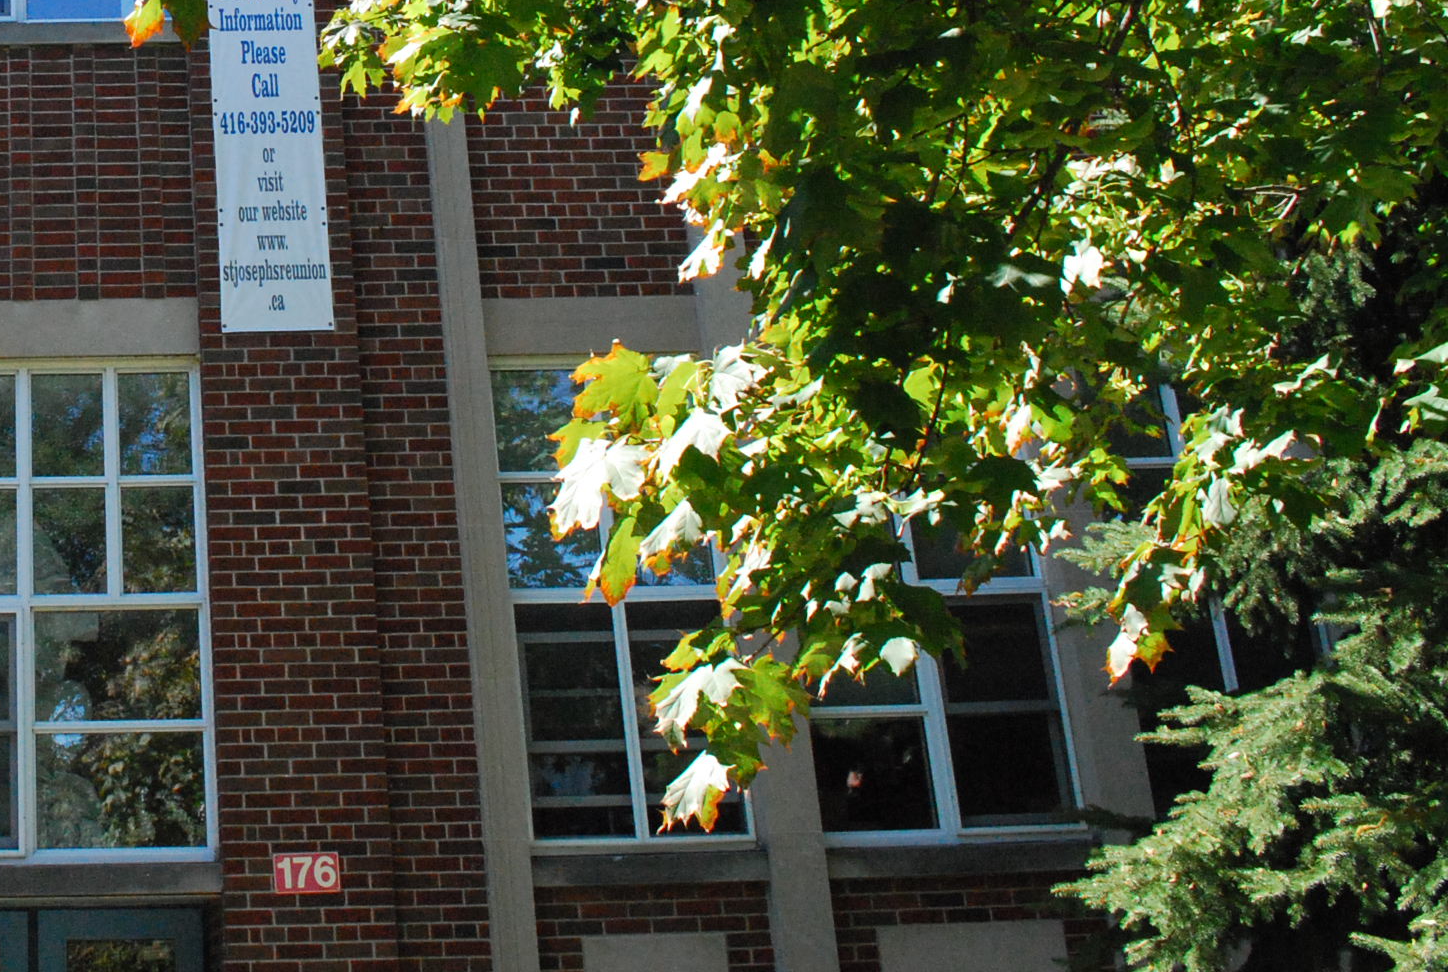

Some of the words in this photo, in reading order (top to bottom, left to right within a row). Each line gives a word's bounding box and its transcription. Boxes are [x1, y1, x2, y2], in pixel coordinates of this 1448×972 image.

[219, 8, 303, 32] Information
[240, 40, 286, 65] Please
[252, 73, 279, 98] Call
[220, 110, 315, 135] 416-393-5209
[263, 147, 275, 163] or
[258, 171, 284, 193] visit
[239, 205, 258, 223] our
[262, 199, 308, 222] website
[257, 234, 288, 251] www.
[223, 259, 327, 288] stjosephsreunion
[269, 294, 285, 311] .ca
[277, 855, 337, 889] 176
